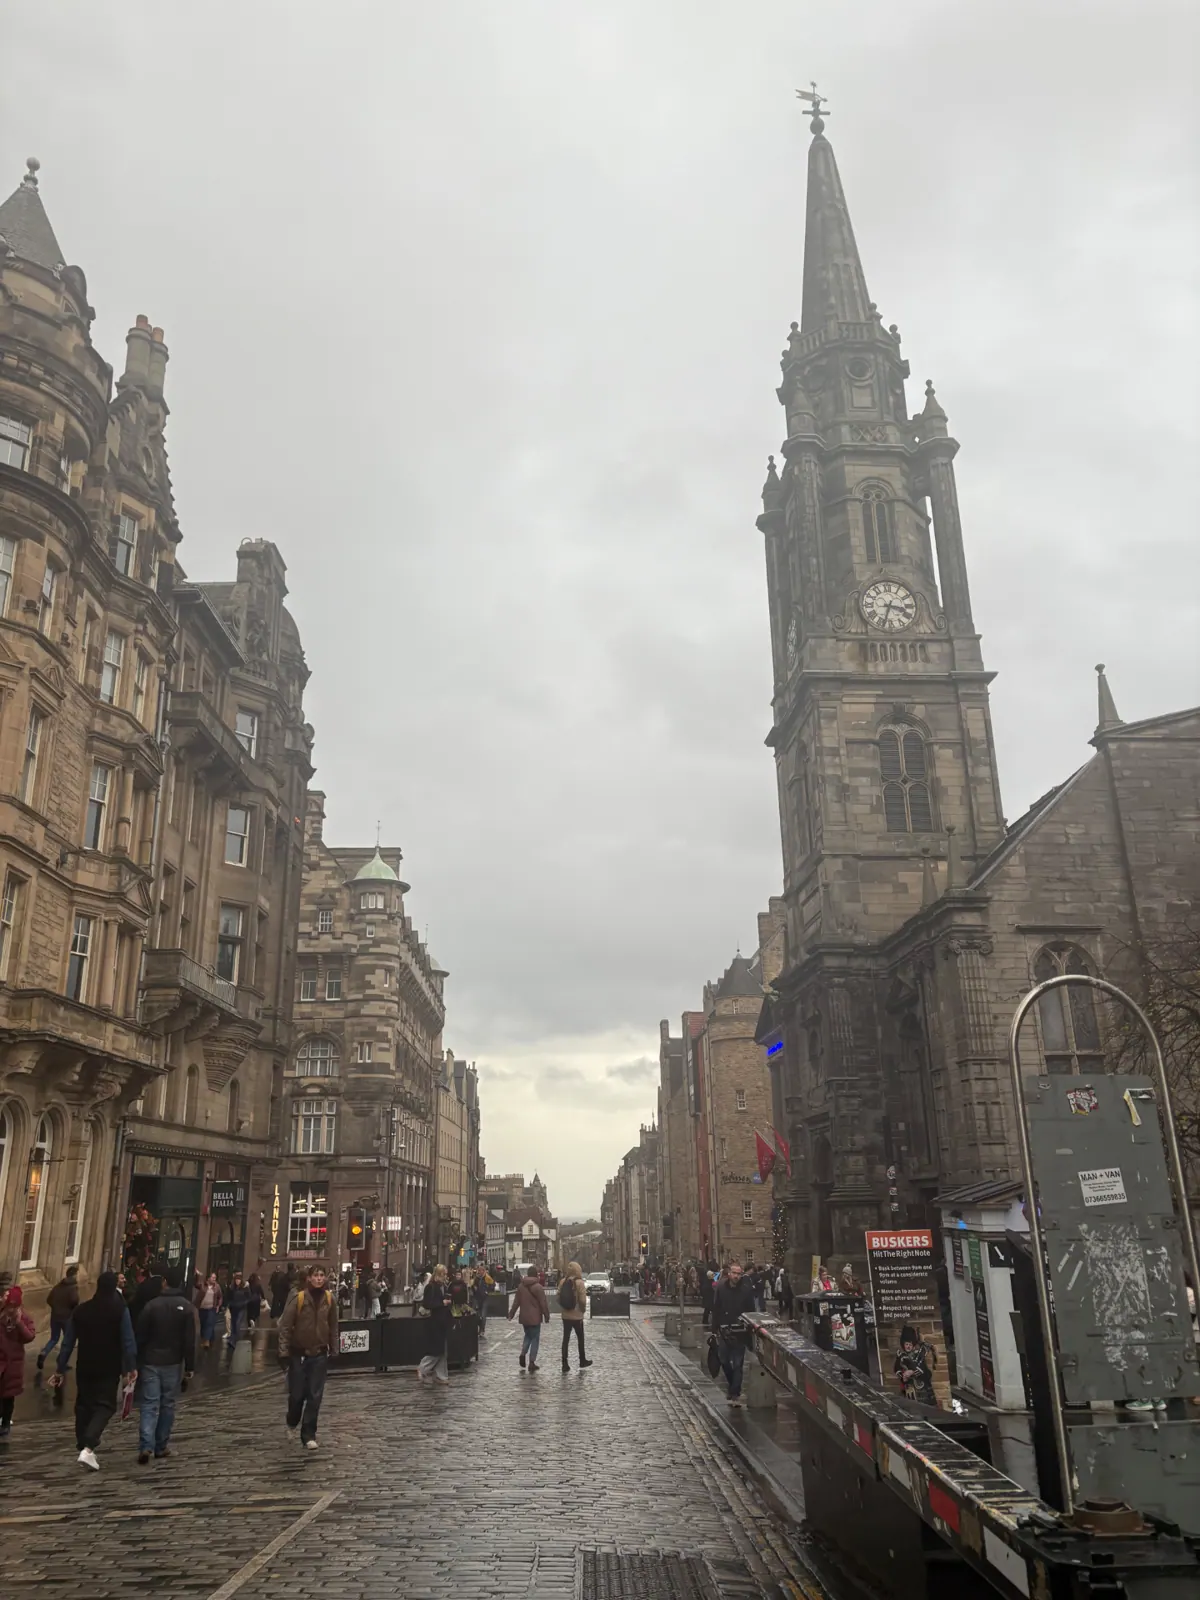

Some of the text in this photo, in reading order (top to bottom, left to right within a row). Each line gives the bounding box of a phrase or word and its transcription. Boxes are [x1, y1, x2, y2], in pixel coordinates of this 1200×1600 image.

[1080, 1173, 1098, 1181] MAN
[1104, 1170, 1120, 1178] VAN
[213, 1192, 234, 1200] BELLA
[270, 1184, 280, 1255] LANDYS
[871, 1235, 929, 1248] BUSKERS
[896, 1250, 914, 1258] Right
[915, 1249, 931, 1257] Note
